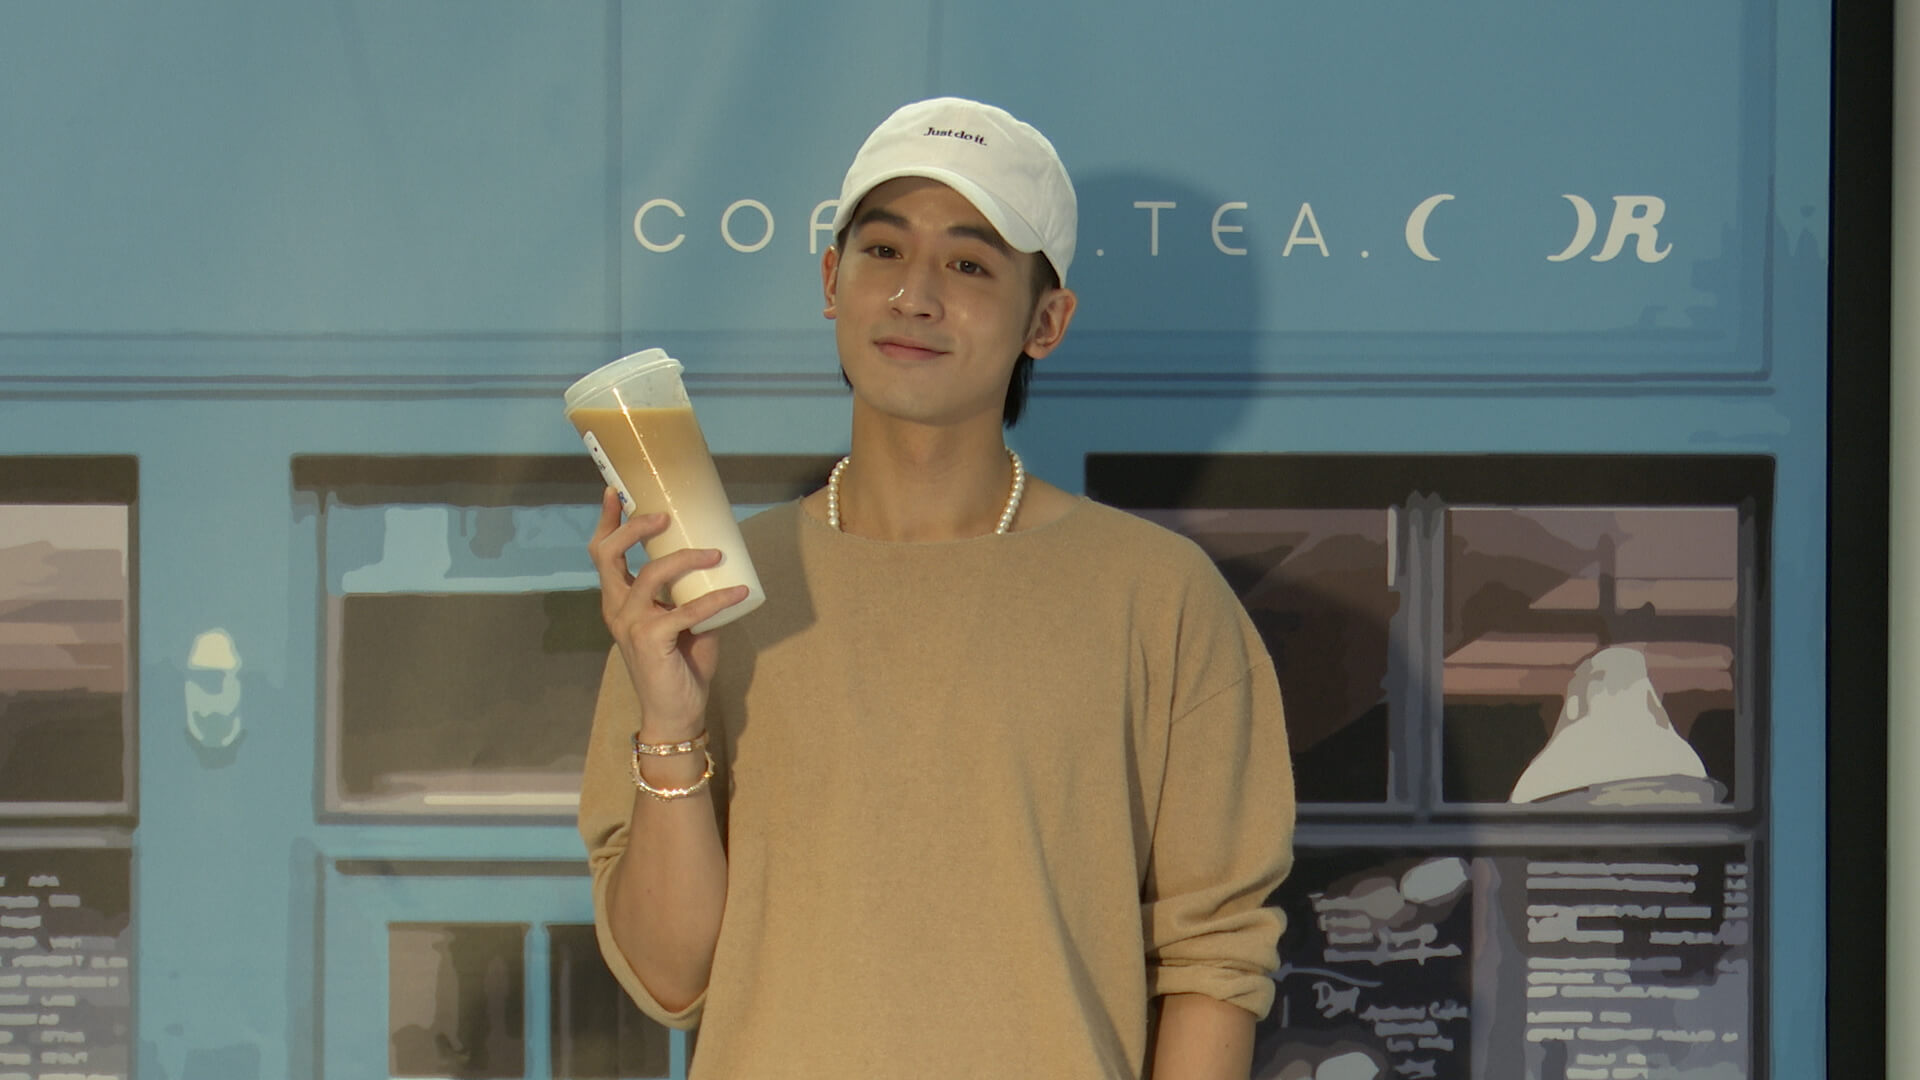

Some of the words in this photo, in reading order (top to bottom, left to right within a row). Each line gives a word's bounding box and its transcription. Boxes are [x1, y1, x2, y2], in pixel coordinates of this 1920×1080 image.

[923, 127, 952, 137] Just
[954, 130, 973, 140] do
[974, 134, 987, 146] it.
[633, 198, 841, 254] COF
